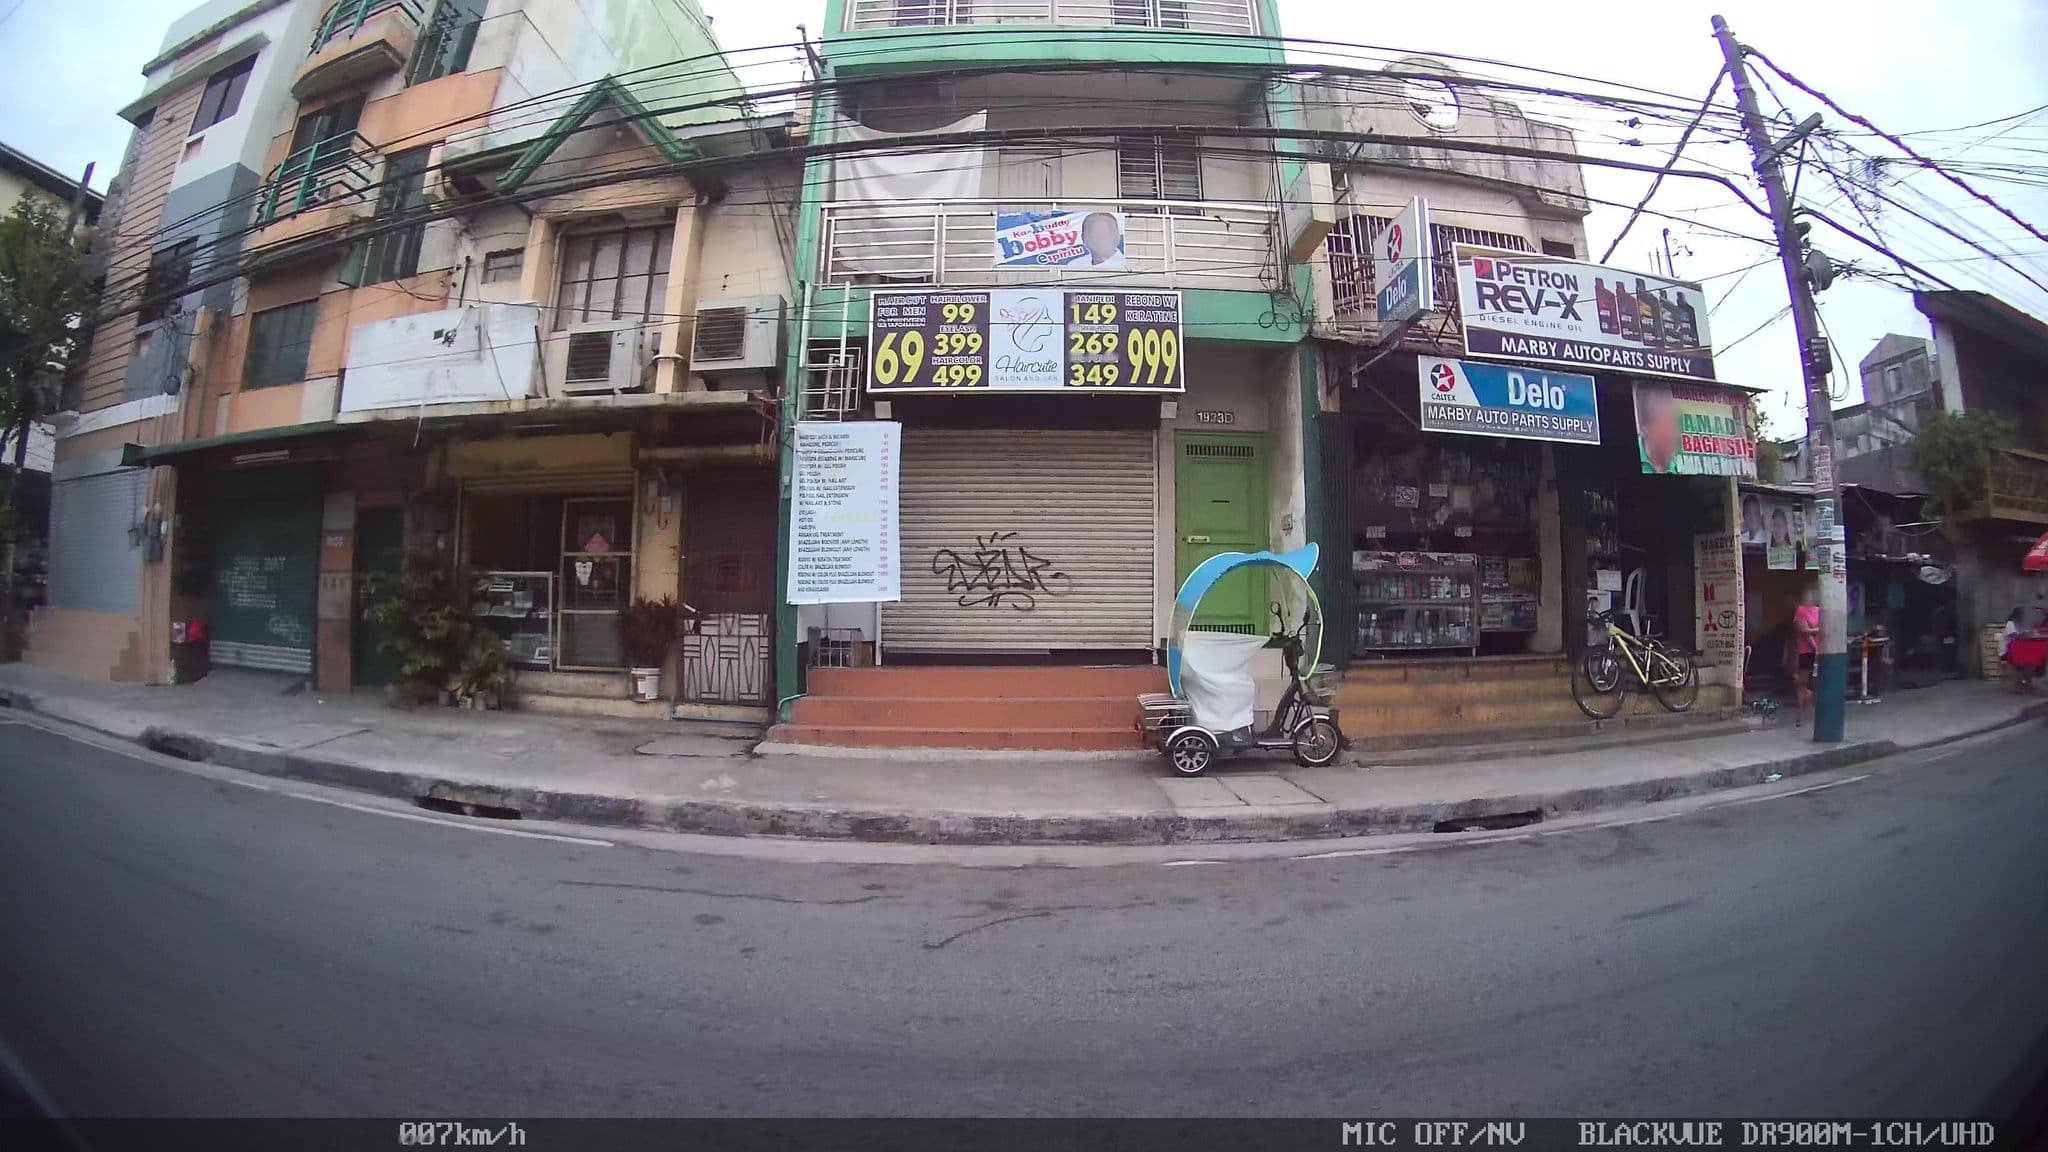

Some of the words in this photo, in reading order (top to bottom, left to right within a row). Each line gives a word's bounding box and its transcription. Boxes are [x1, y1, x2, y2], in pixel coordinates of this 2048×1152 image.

[1012, 220, 1070, 238] Ka-buddy
[998, 230, 1078, 259] bobby
[1037, 245, 1084, 263] espiritu
[1496, 261, 1579, 292] PETRON
[878, 295, 926, 306] HAIRCUT
[930, 295, 987, 304] HAIRBLOWER
[1125, 295, 1161, 306] REBOND
[1162, 295, 1177, 308] W/
[1386, 276, 1407, 311] Delo
[1476, 281, 1583, 321] REV-X
[877, 308, 898, 316] FOR
[903, 307, 926, 316] MEN
[942, 304, 975, 324] 99
[1071, 304, 1117, 324] 149
[1125, 310, 1178, 323] KERATINE
[1479, 314, 1520, 324] DIESEL
[1524, 319, 1562, 329] ENGINE
[887, 318, 926, 327] WOMEN
[933, 333, 983, 356] 399
[1070, 333, 1119, 355] 269
[875, 330, 925, 385] 69
[931, 356, 983, 365] HAIRCOLOR
[996, 355, 1057, 373] Haircutie
[1127, 328, 1178, 385] 999
[1500, 336, 1557, 358] MARBY
[1563, 343, 1644, 367] AUTOPARTS
[1647, 353, 1691, 373] SUPPLY
[932, 365, 982, 387] 499
[1070, 364, 1119, 387] 349
[1431, 393, 1457, 402] CALTEX
[1507, 373, 1565, 410] Delo
[1428, 405, 1473, 421] MARBY
[1476, 409, 1509, 425] AUTO
[1512, 413, 1549, 429] PARTS
[1551, 416, 1593, 433] SUPPLY
